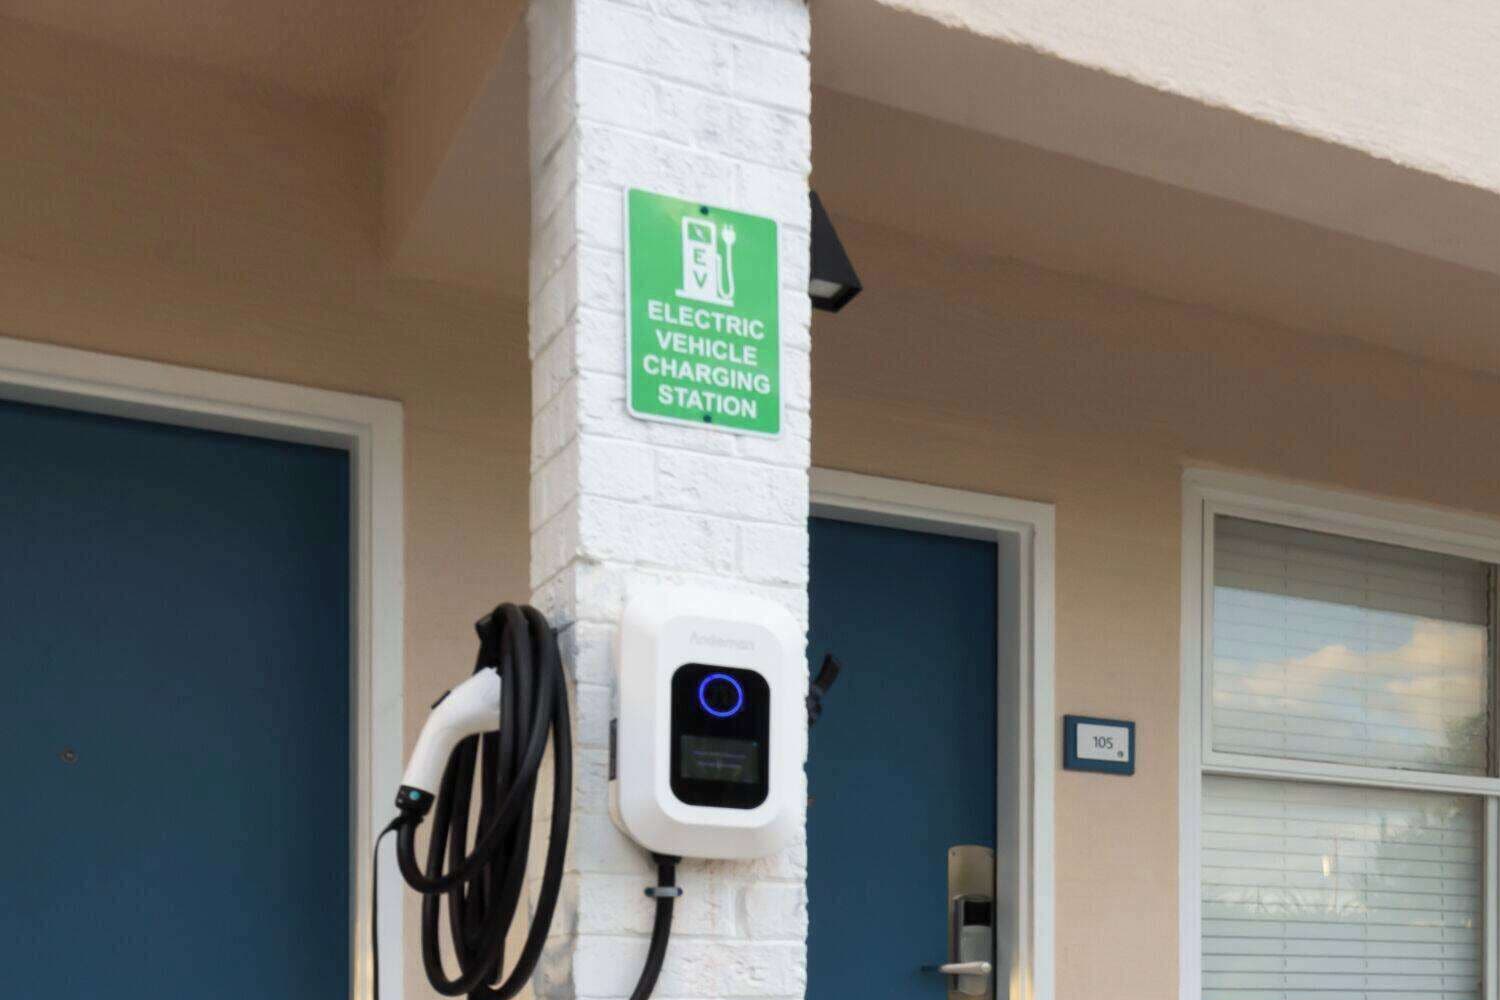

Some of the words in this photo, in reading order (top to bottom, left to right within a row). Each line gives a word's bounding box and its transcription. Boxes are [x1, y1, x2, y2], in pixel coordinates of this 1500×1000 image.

[648, 299, 765, 340] ELECTRIC
[656, 329, 758, 366] VEHICLE
[643, 354, 771, 394] CHARGING
[658, 383, 757, 418] STATION
[1092, 736, 1113, 749] 105
